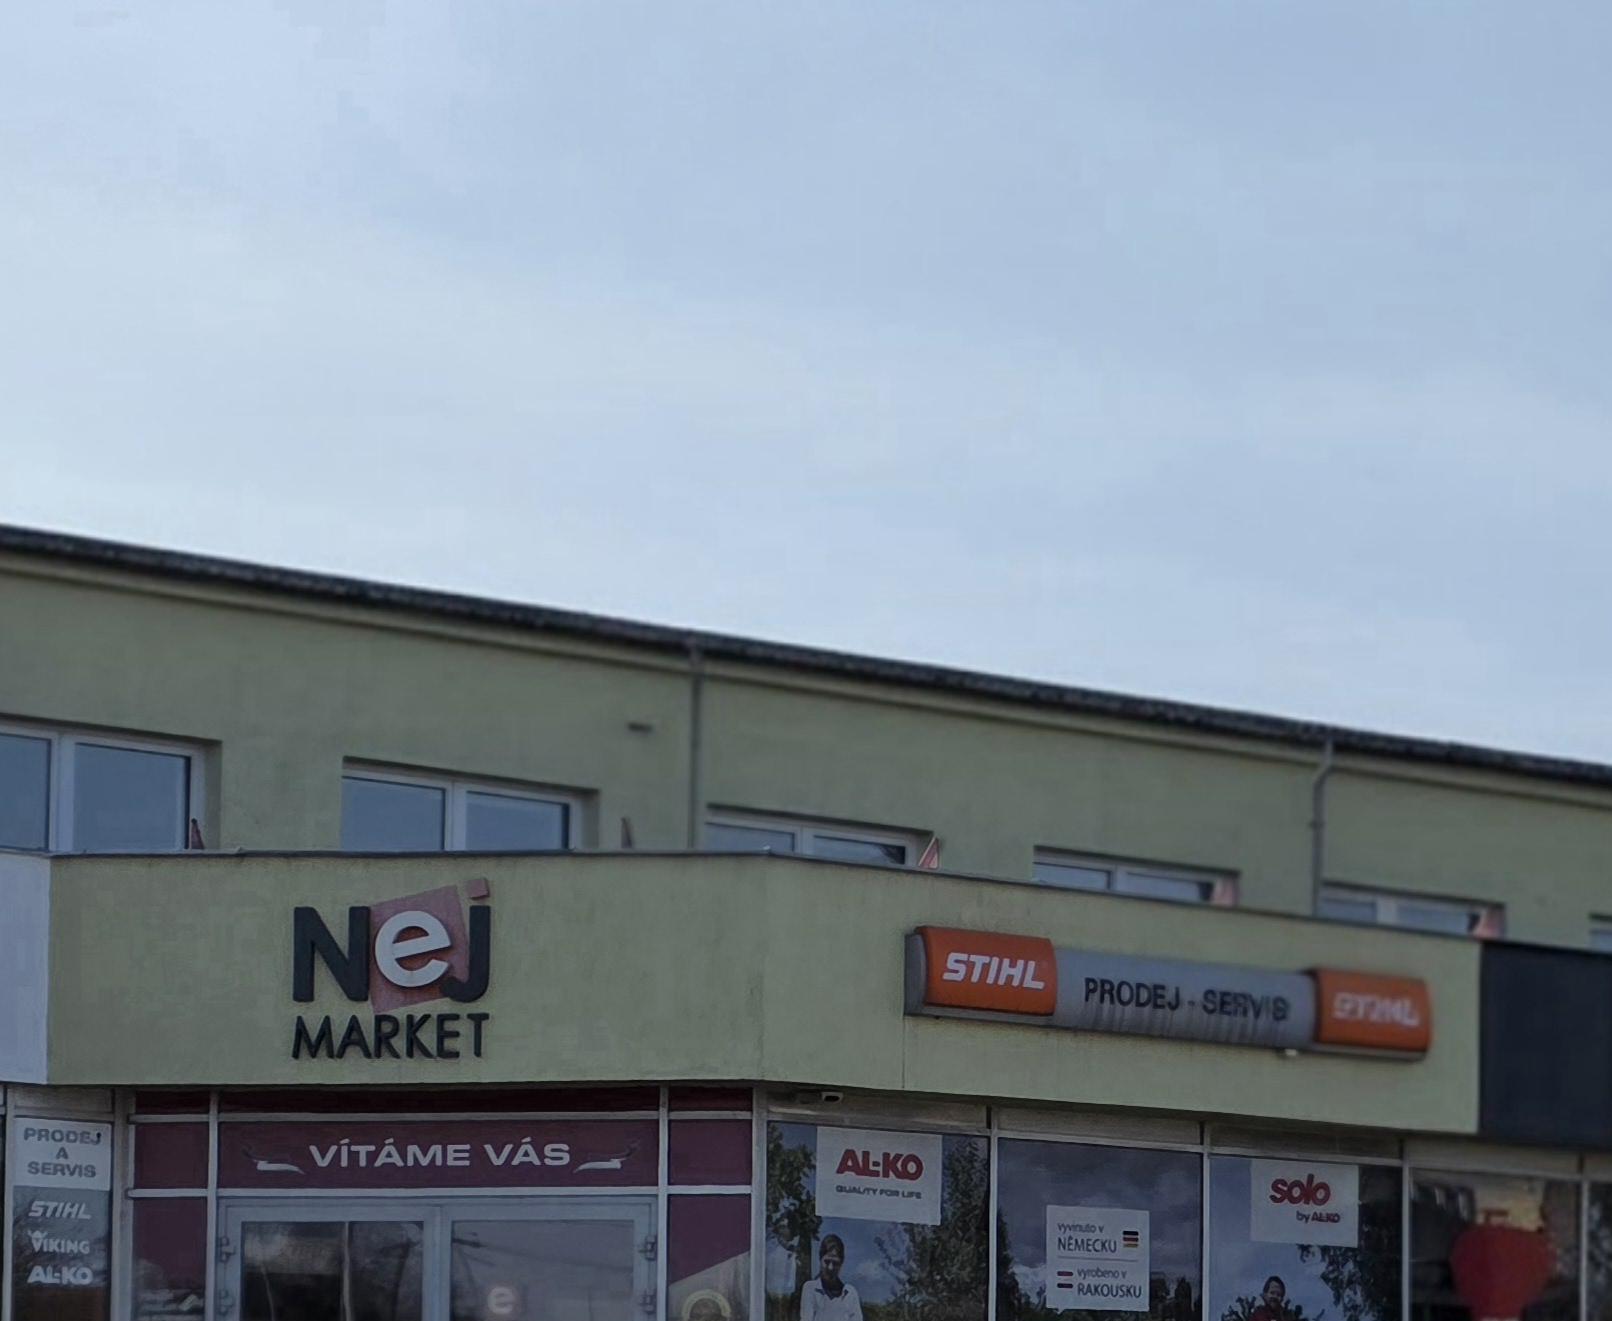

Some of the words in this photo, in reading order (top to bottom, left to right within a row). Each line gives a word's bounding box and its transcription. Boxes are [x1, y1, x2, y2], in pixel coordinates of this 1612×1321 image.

[942, 952, 1046, 990] STIHL
[1083, 977, 1181, 1011] PRODEJ
[1202, 988, 1289, 1022] SERVIS
[292, 1012, 490, 1059] MARKET
[24, 1127, 101, 1145] PRODEJ
[56, 1147, 69, 1160] A
[309, 1137, 471, 1168] VÍTÁME
[484, 1136, 570, 1166] VÁS
[27, 1161, 96, 1178] SERVIS
[836, 1149, 924, 1180] AL-KO
[836, 1185, 878, 1196] QUALITY
[880, 1189, 899, 1197] FOR
[902, 1190, 921, 1199] LIFE
[1269, 1173, 1330, 1206] solo
[28, 1201, 91, 1219] STIHL
[1296, 1210, 1310, 1223] by
[30, 1233, 90, 1254] VIKING
[1057, 1235, 1117, 1253] NĚMECKU
[27, 1265, 93, 1285] AL-KO
[1077, 1267, 1119, 1280] vyrobeno
[1077, 1283, 1142, 1298] RAKOUSKU
